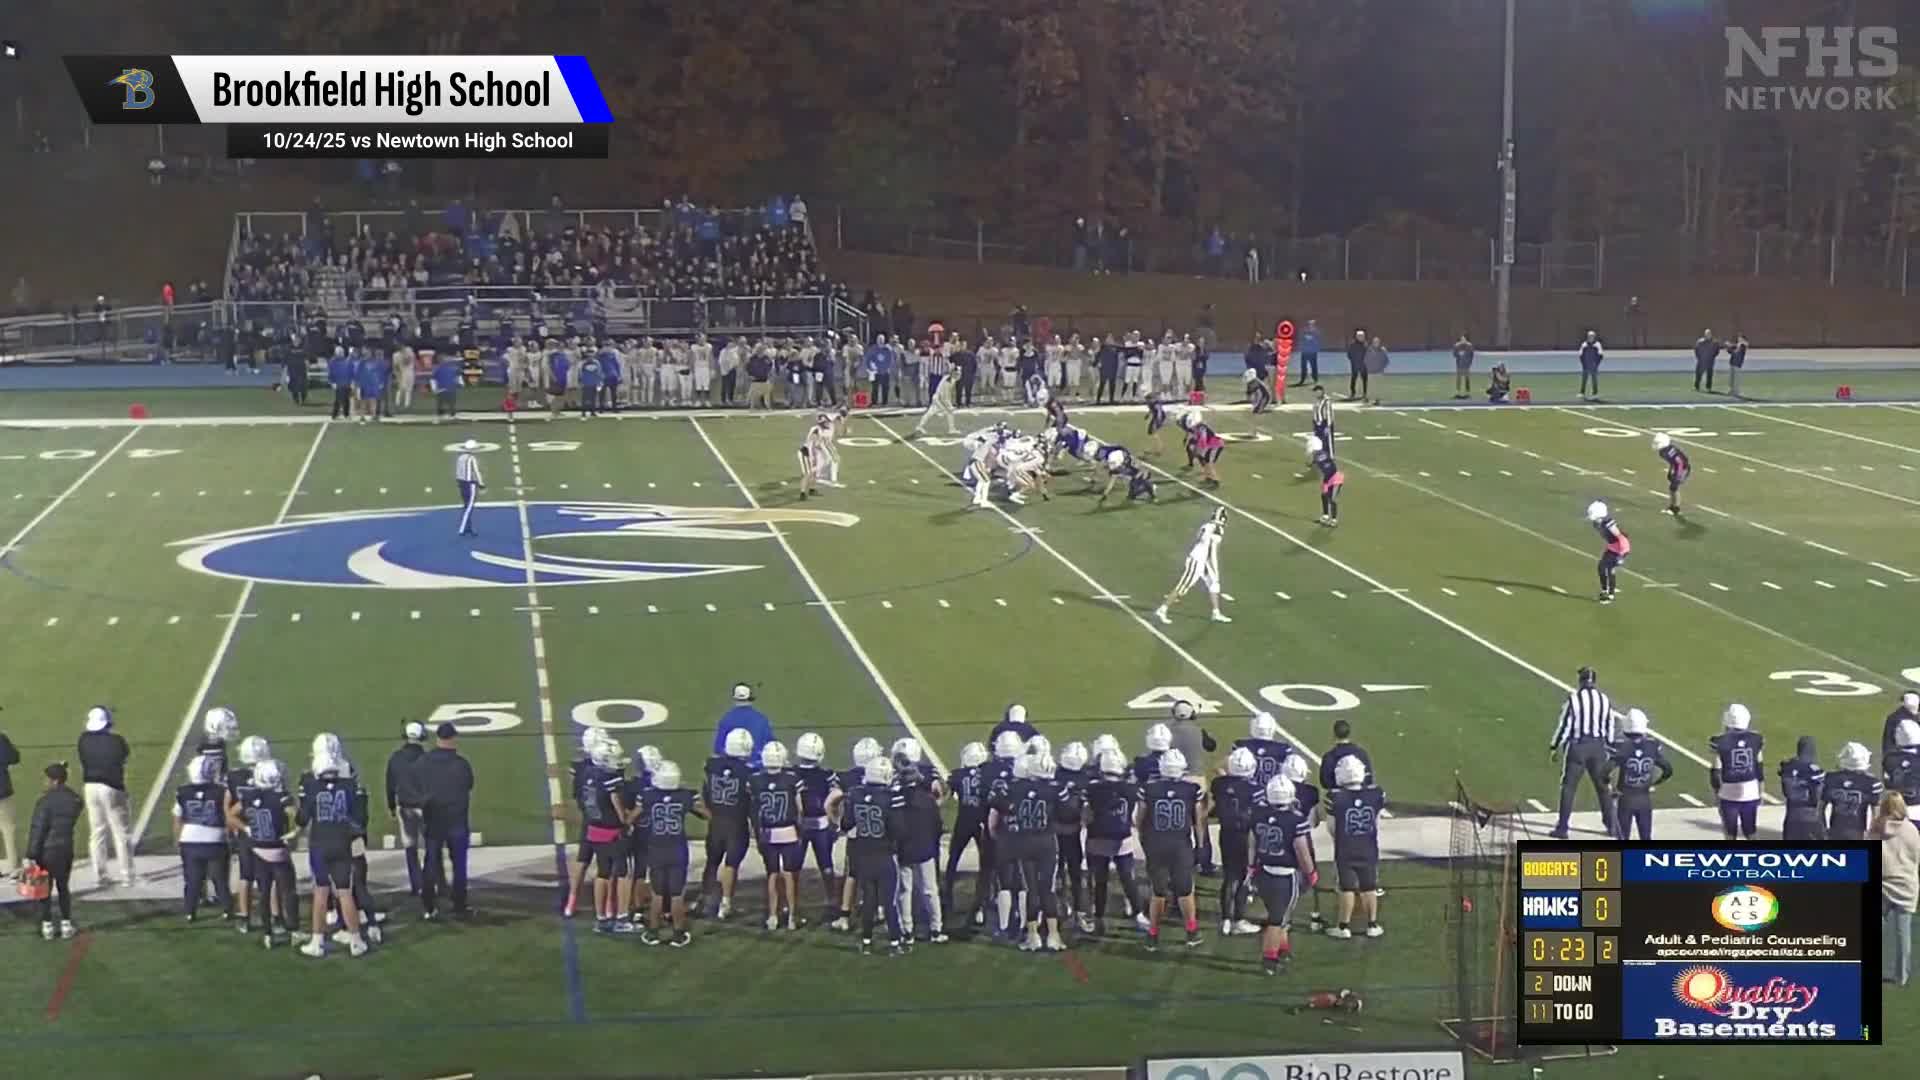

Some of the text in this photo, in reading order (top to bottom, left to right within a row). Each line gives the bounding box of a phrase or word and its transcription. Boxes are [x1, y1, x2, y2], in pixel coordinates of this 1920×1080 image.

[711, 773, 739, 805] 52
[652, 802, 683, 835] 65
[759, 791, 788, 824] 27
[1018, 799, 1048, 829] 44
[1154, 799, 1186, 831] 60
